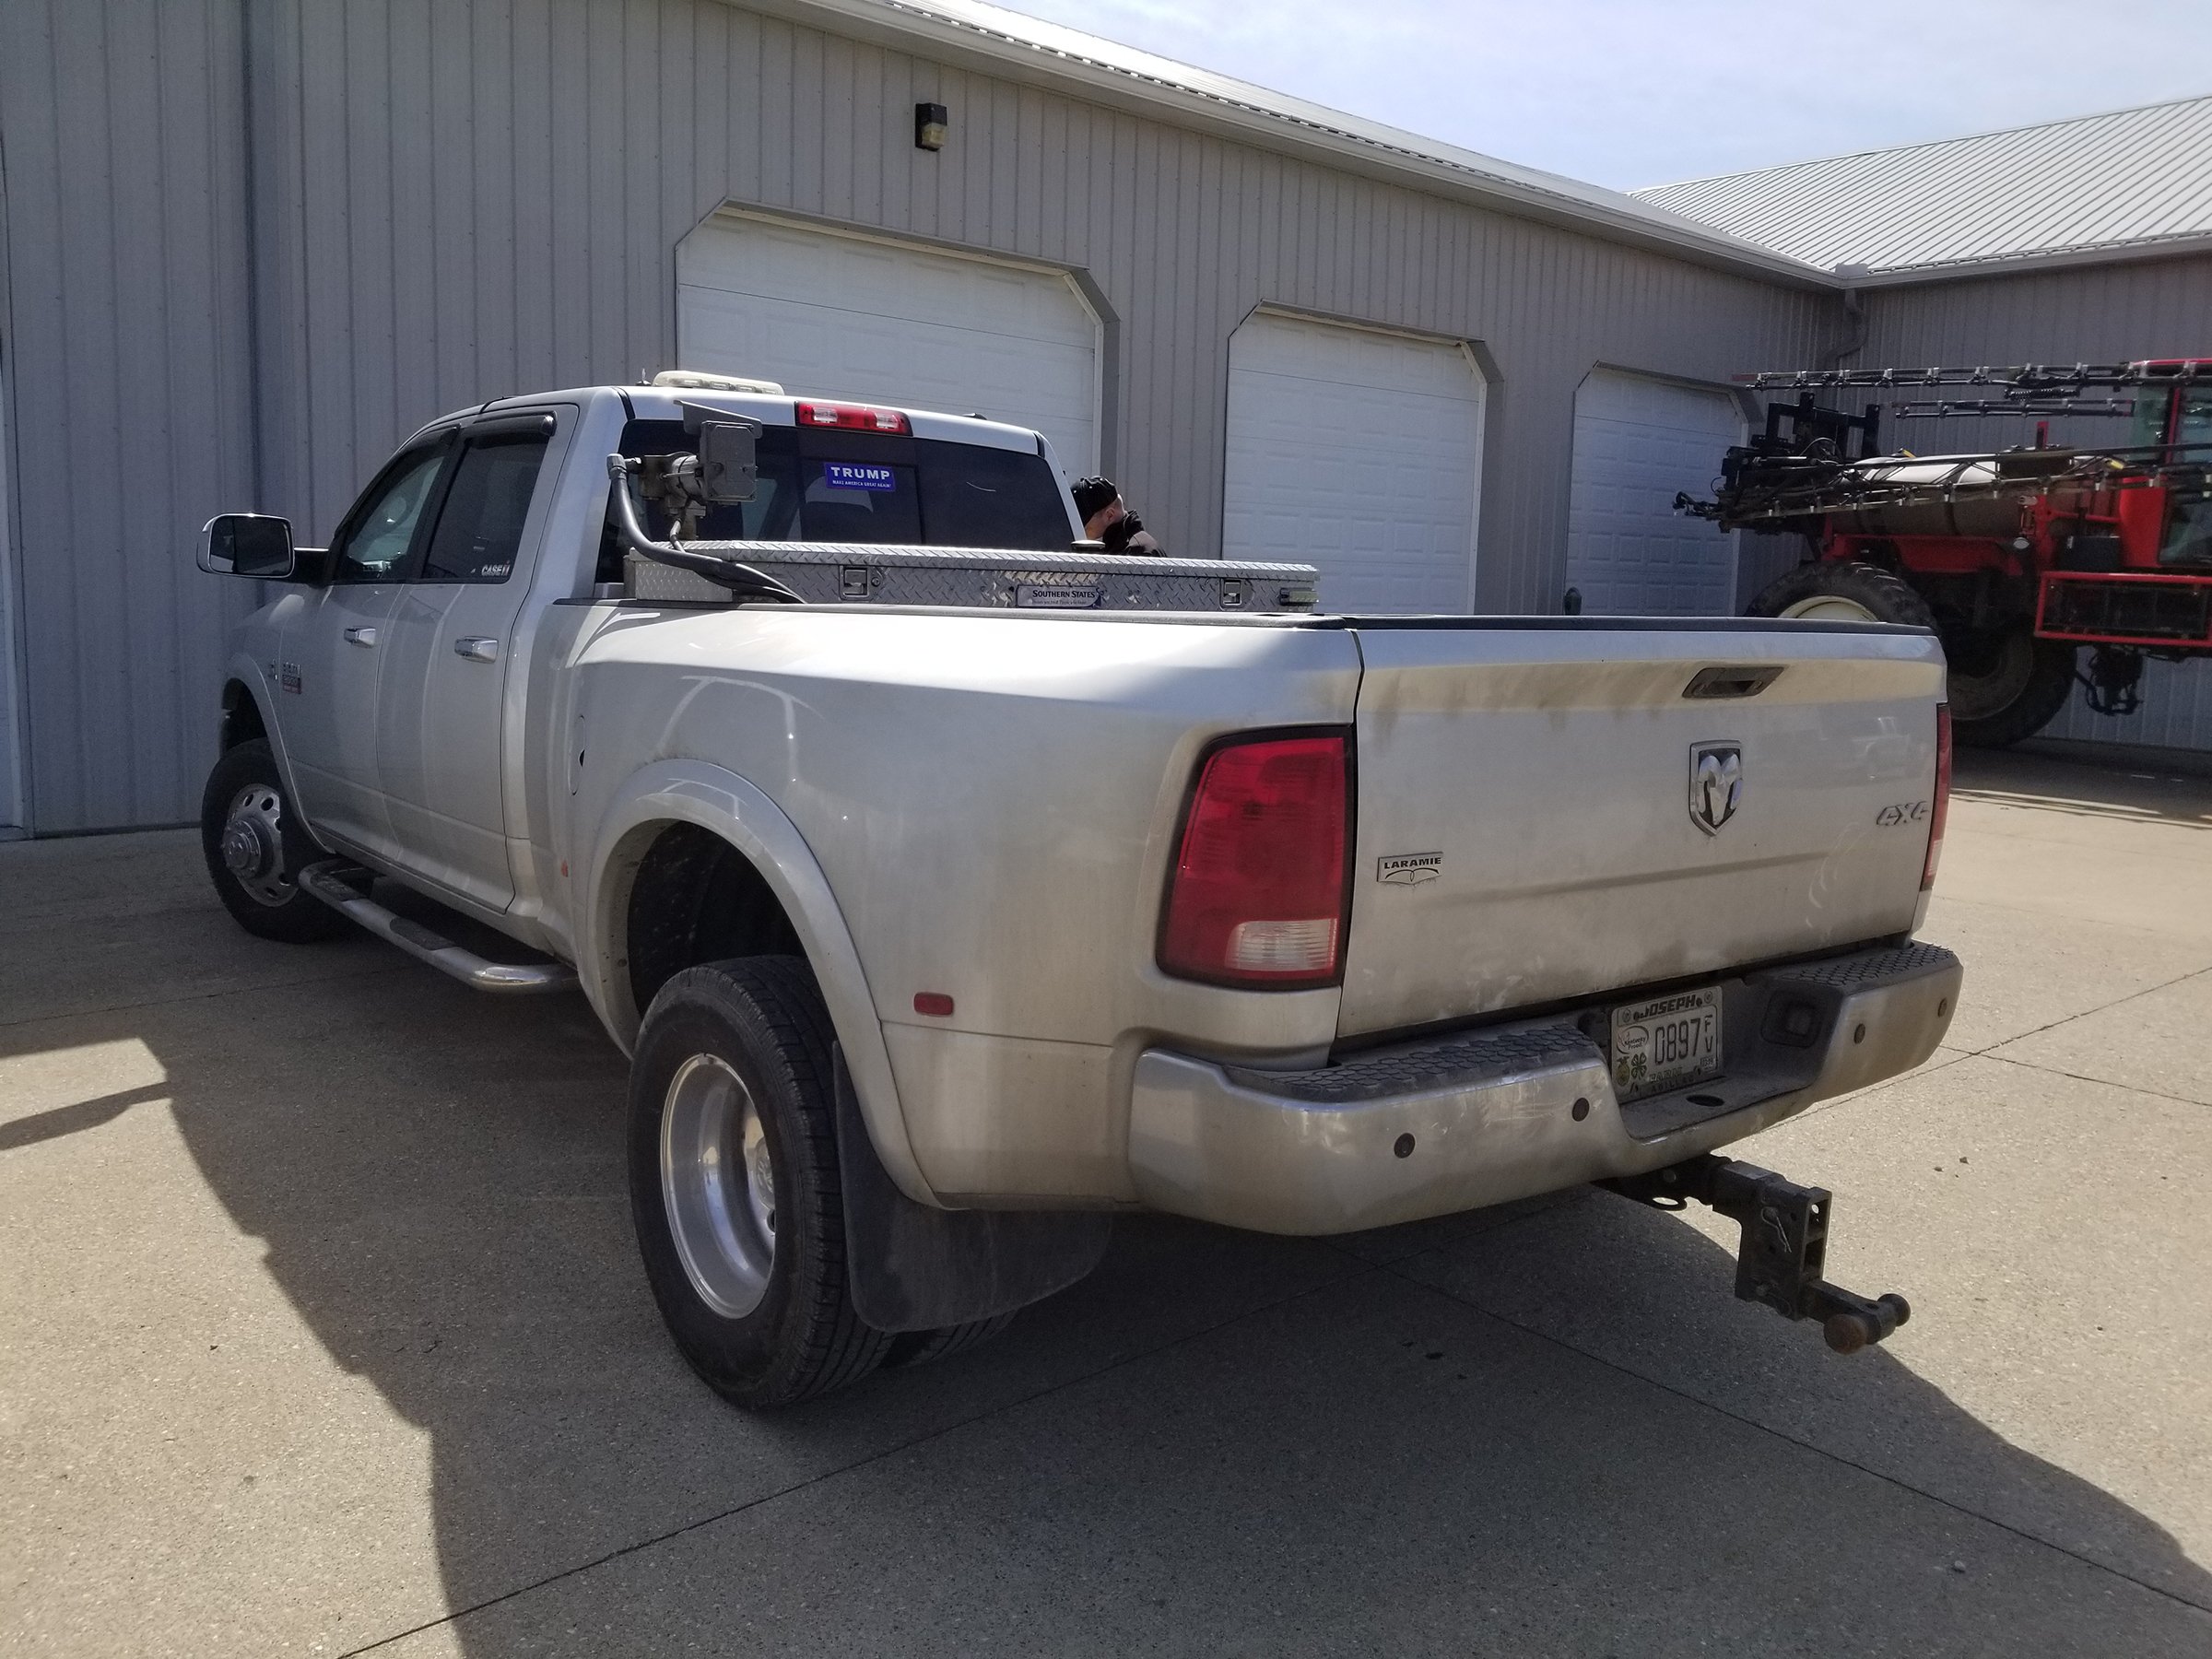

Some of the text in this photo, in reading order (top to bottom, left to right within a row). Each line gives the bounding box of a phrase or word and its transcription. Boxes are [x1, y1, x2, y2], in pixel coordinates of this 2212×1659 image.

[830, 466, 890, 479] TRUMP
[1384, 857, 1441, 869] LARAMIE
[1639, 994, 1696, 1018] JOSEPH
